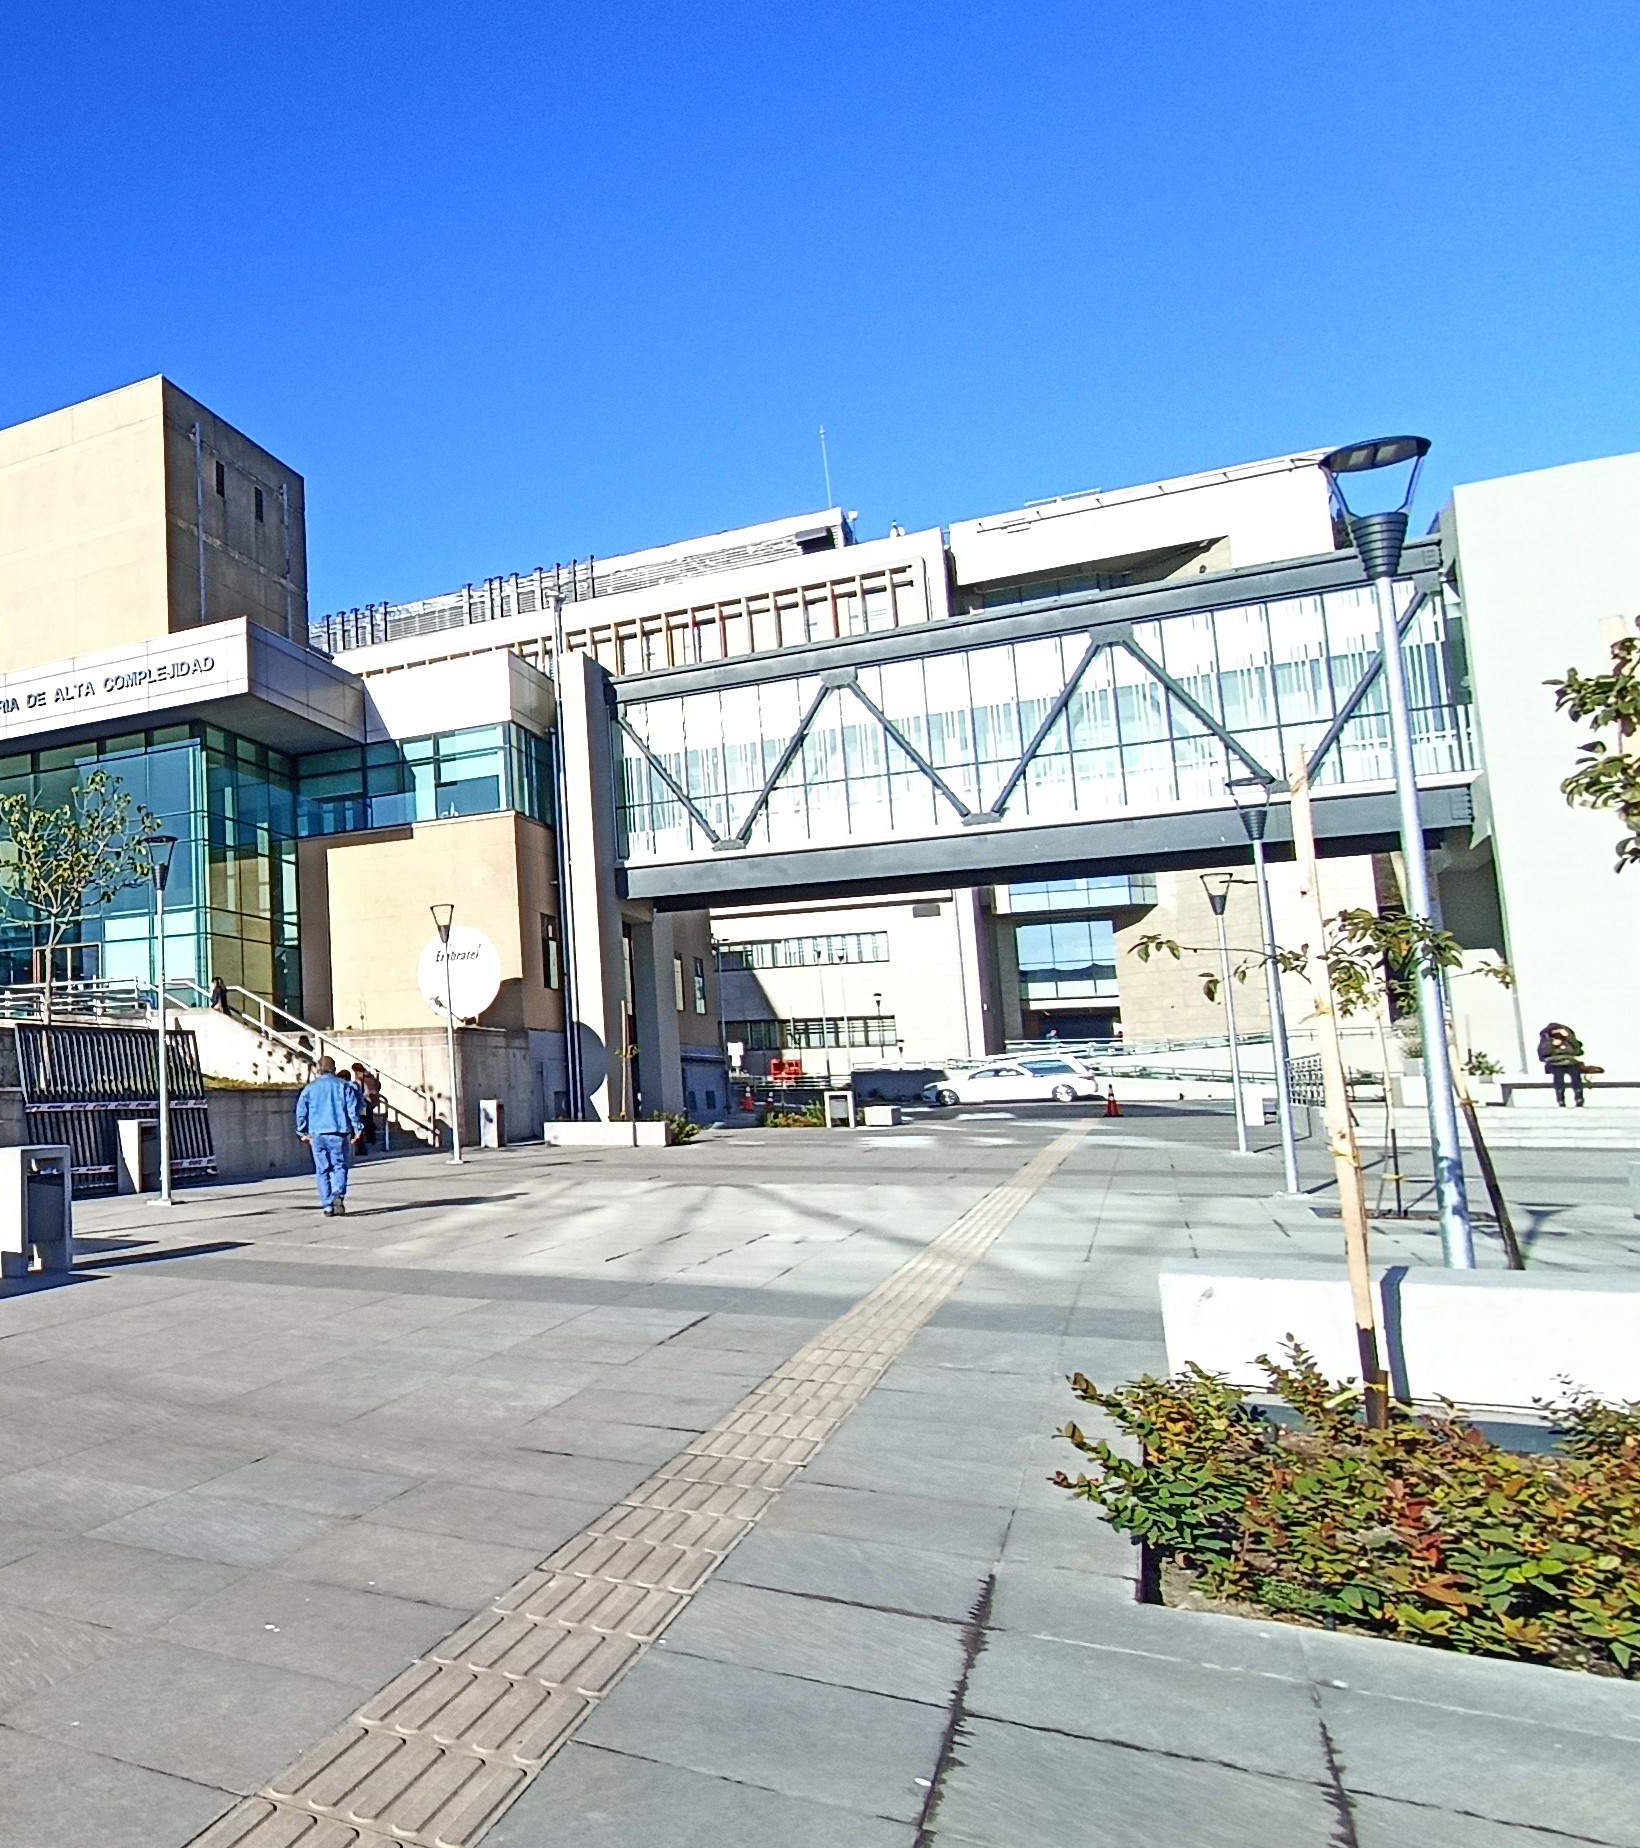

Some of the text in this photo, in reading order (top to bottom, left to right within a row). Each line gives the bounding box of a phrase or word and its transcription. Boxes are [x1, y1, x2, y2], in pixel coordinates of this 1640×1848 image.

[26, 691, 47, 709] DE
[54, 681, 96, 703] ALTA
[103, 656, 215, 693] COMPLEJIDAD
